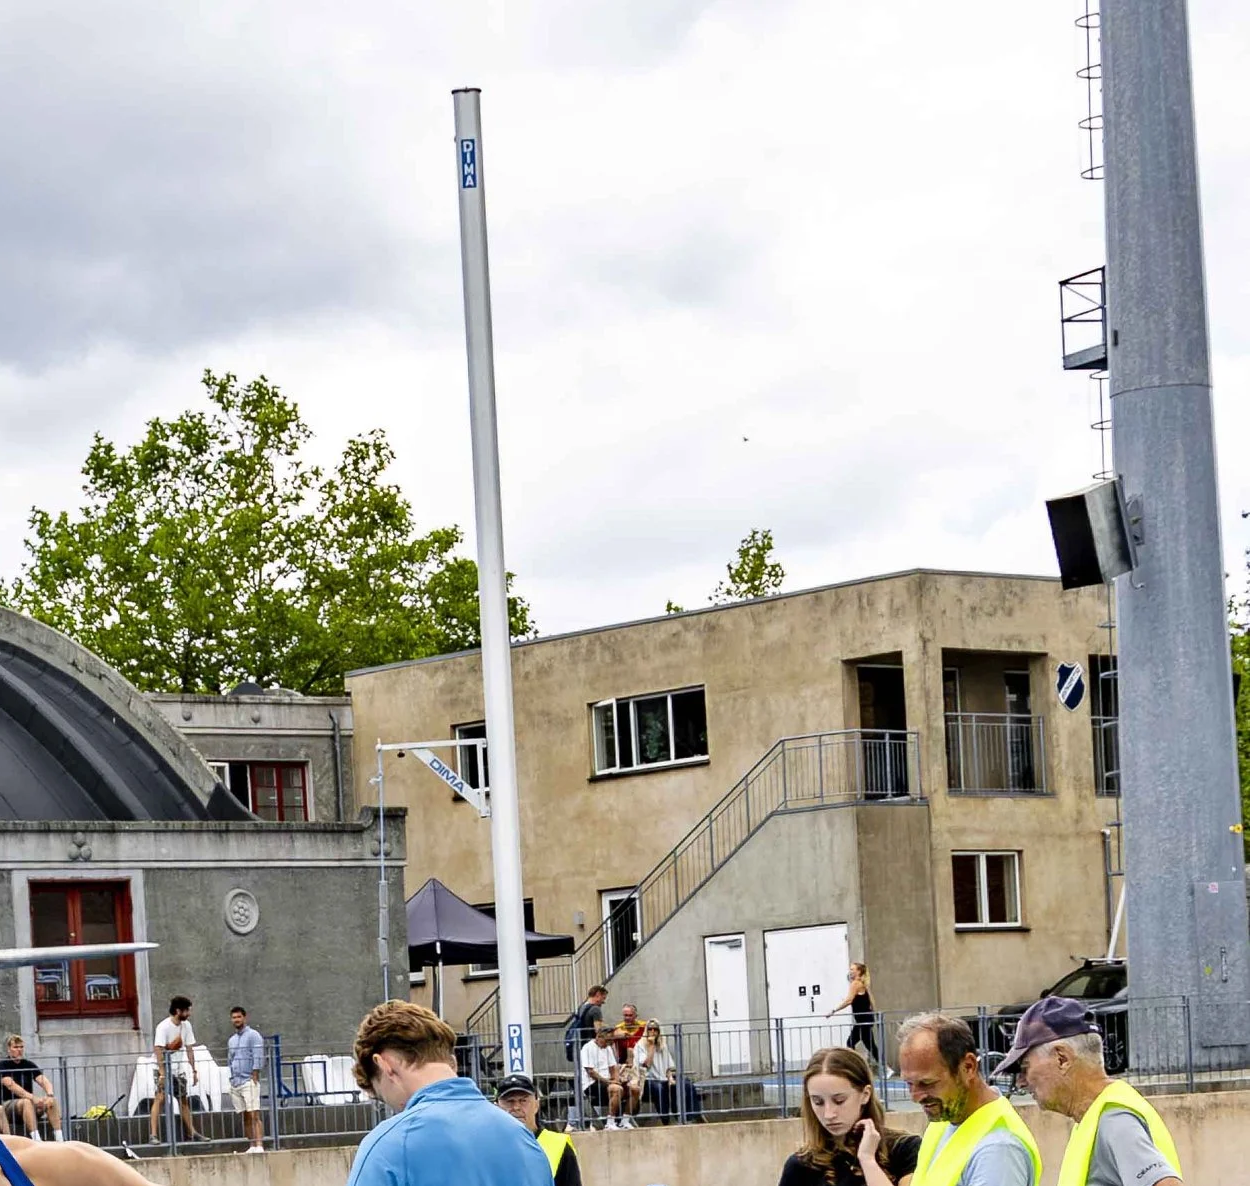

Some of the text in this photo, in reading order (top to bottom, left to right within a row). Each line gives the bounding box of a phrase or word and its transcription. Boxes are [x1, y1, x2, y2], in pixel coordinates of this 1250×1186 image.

[462, 141, 475, 187] DIMA
[430, 758, 465, 793] DIMA
[509, 1025, 523, 1071] DIMA
